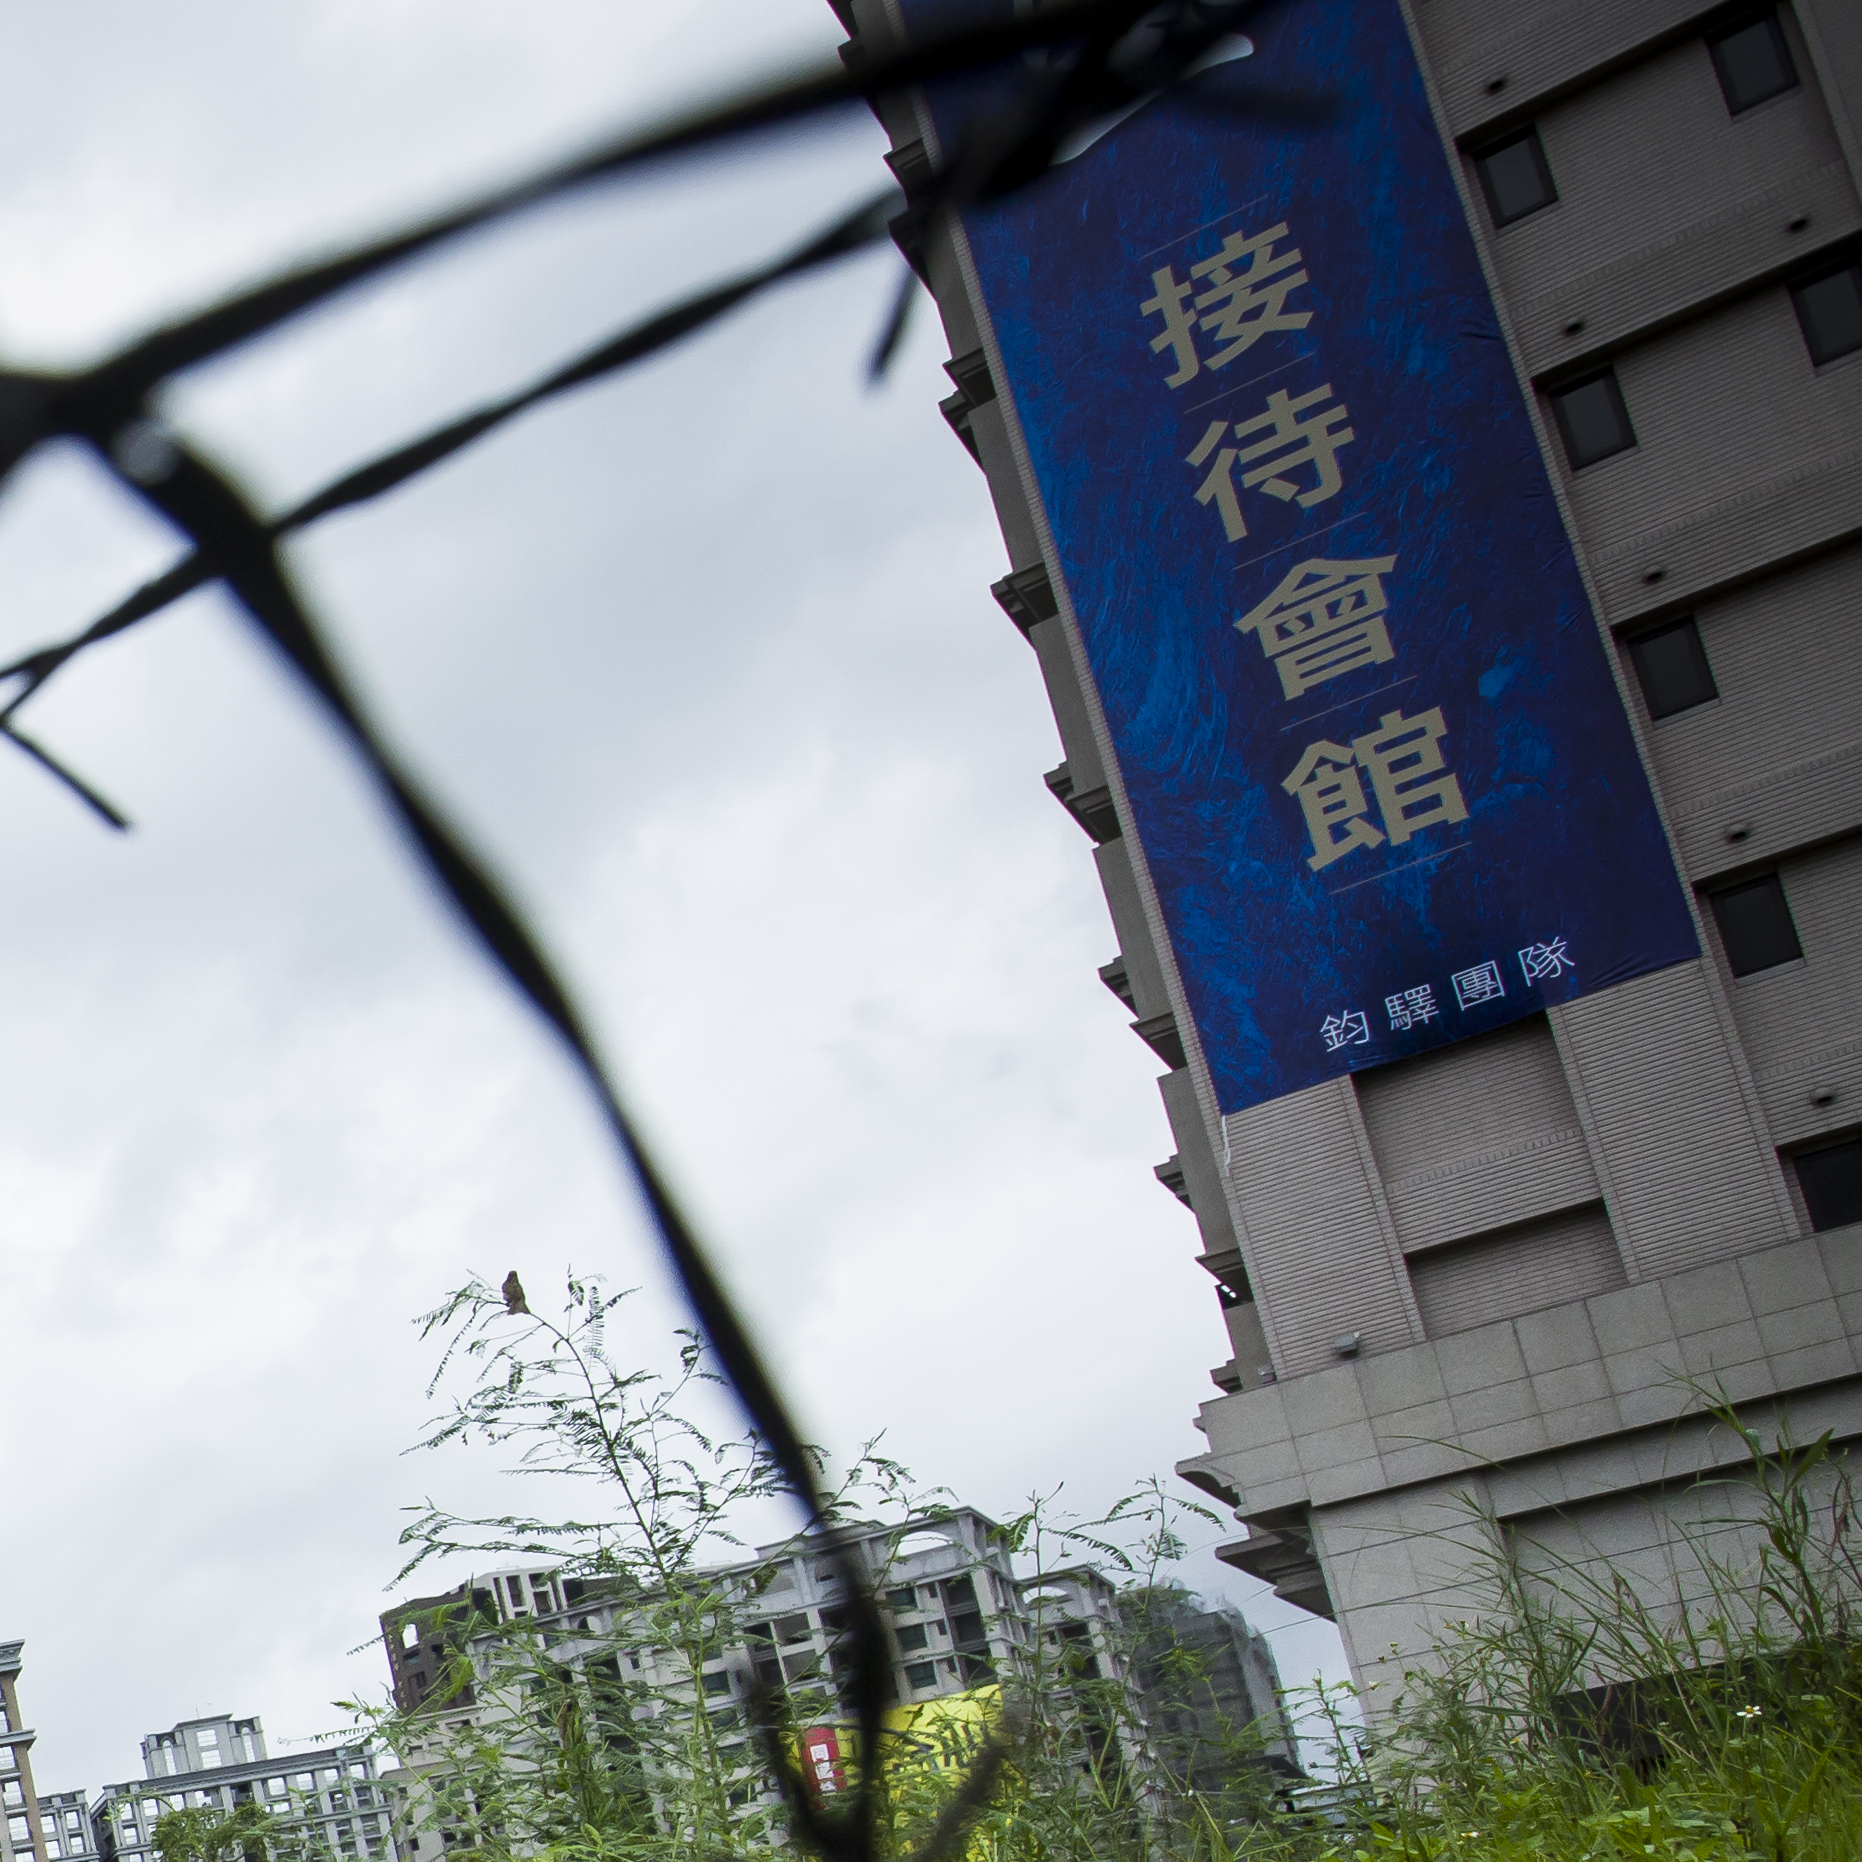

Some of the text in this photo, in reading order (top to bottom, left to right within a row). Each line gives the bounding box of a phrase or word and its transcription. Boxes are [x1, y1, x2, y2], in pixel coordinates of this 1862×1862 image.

[1139, 221, 1471, 873] 接待會館
[1319, 936, 1576, 1053] 鈞驛團隊
